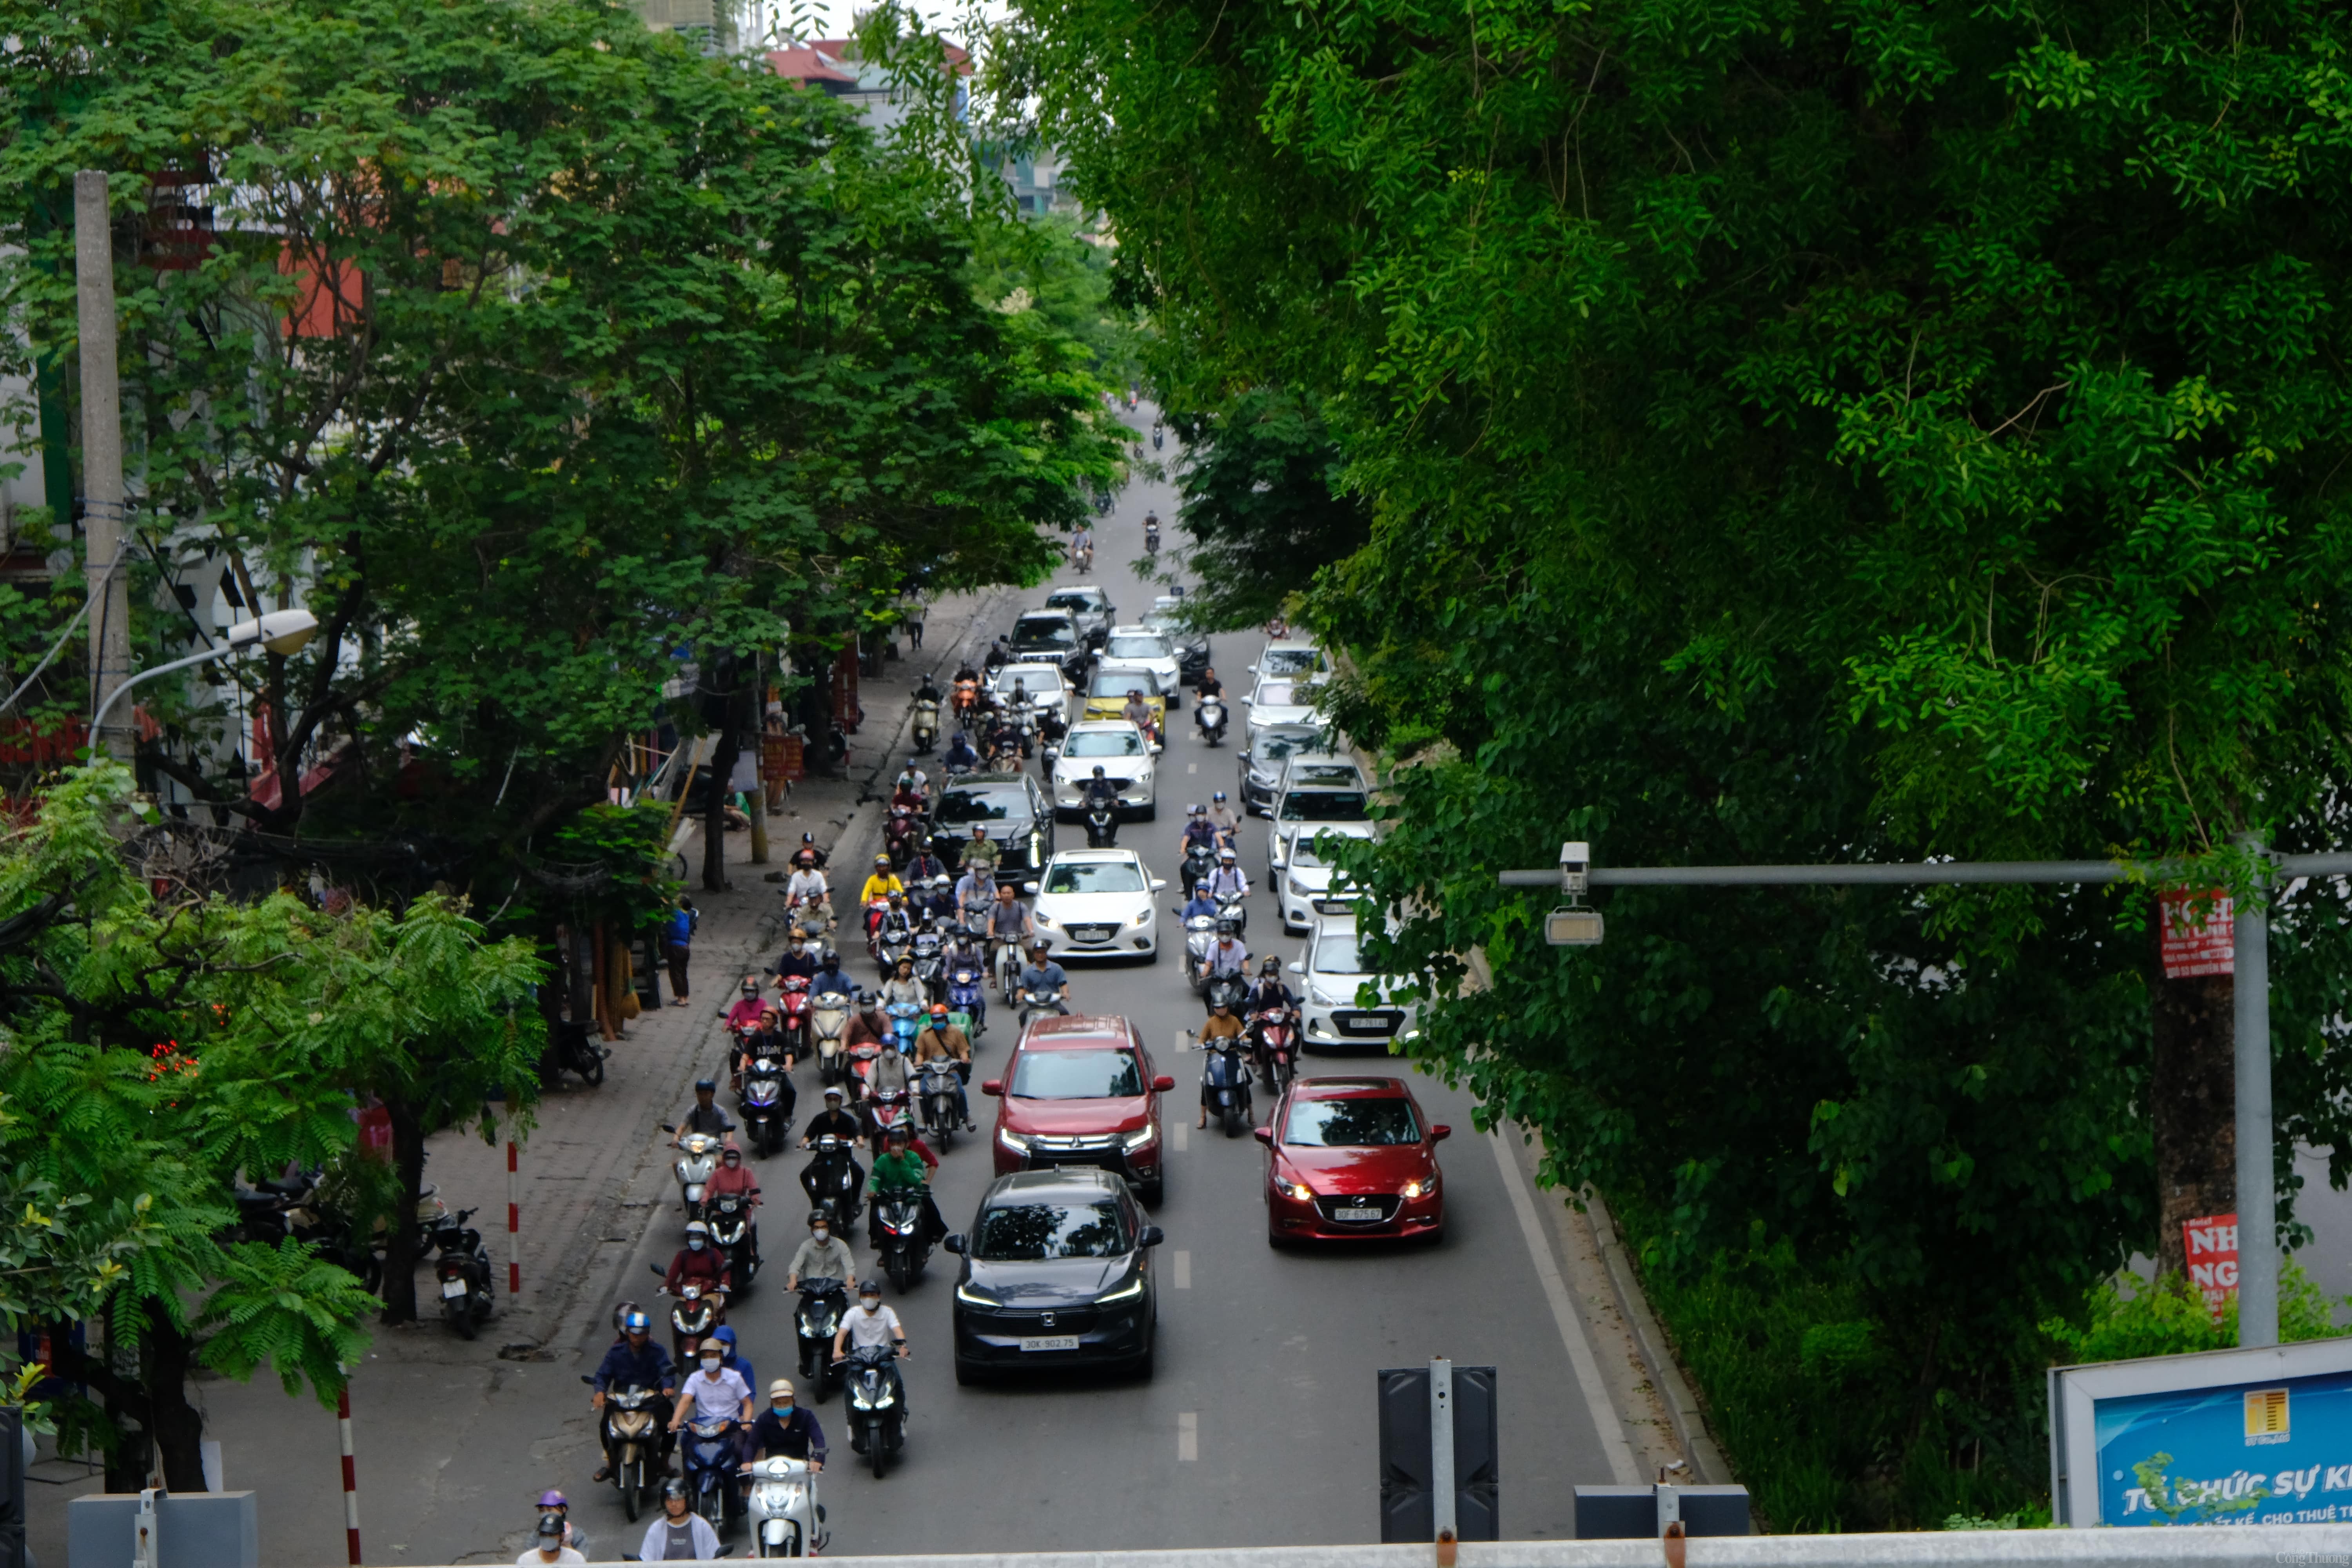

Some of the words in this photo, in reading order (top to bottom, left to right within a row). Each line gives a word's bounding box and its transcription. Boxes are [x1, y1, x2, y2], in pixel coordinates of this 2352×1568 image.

[2272, 1464, 2321, 1500] SỰ
[2262, 1512, 2294, 1525] CHO
[2296, 1504, 2337, 1523] THUÊ
